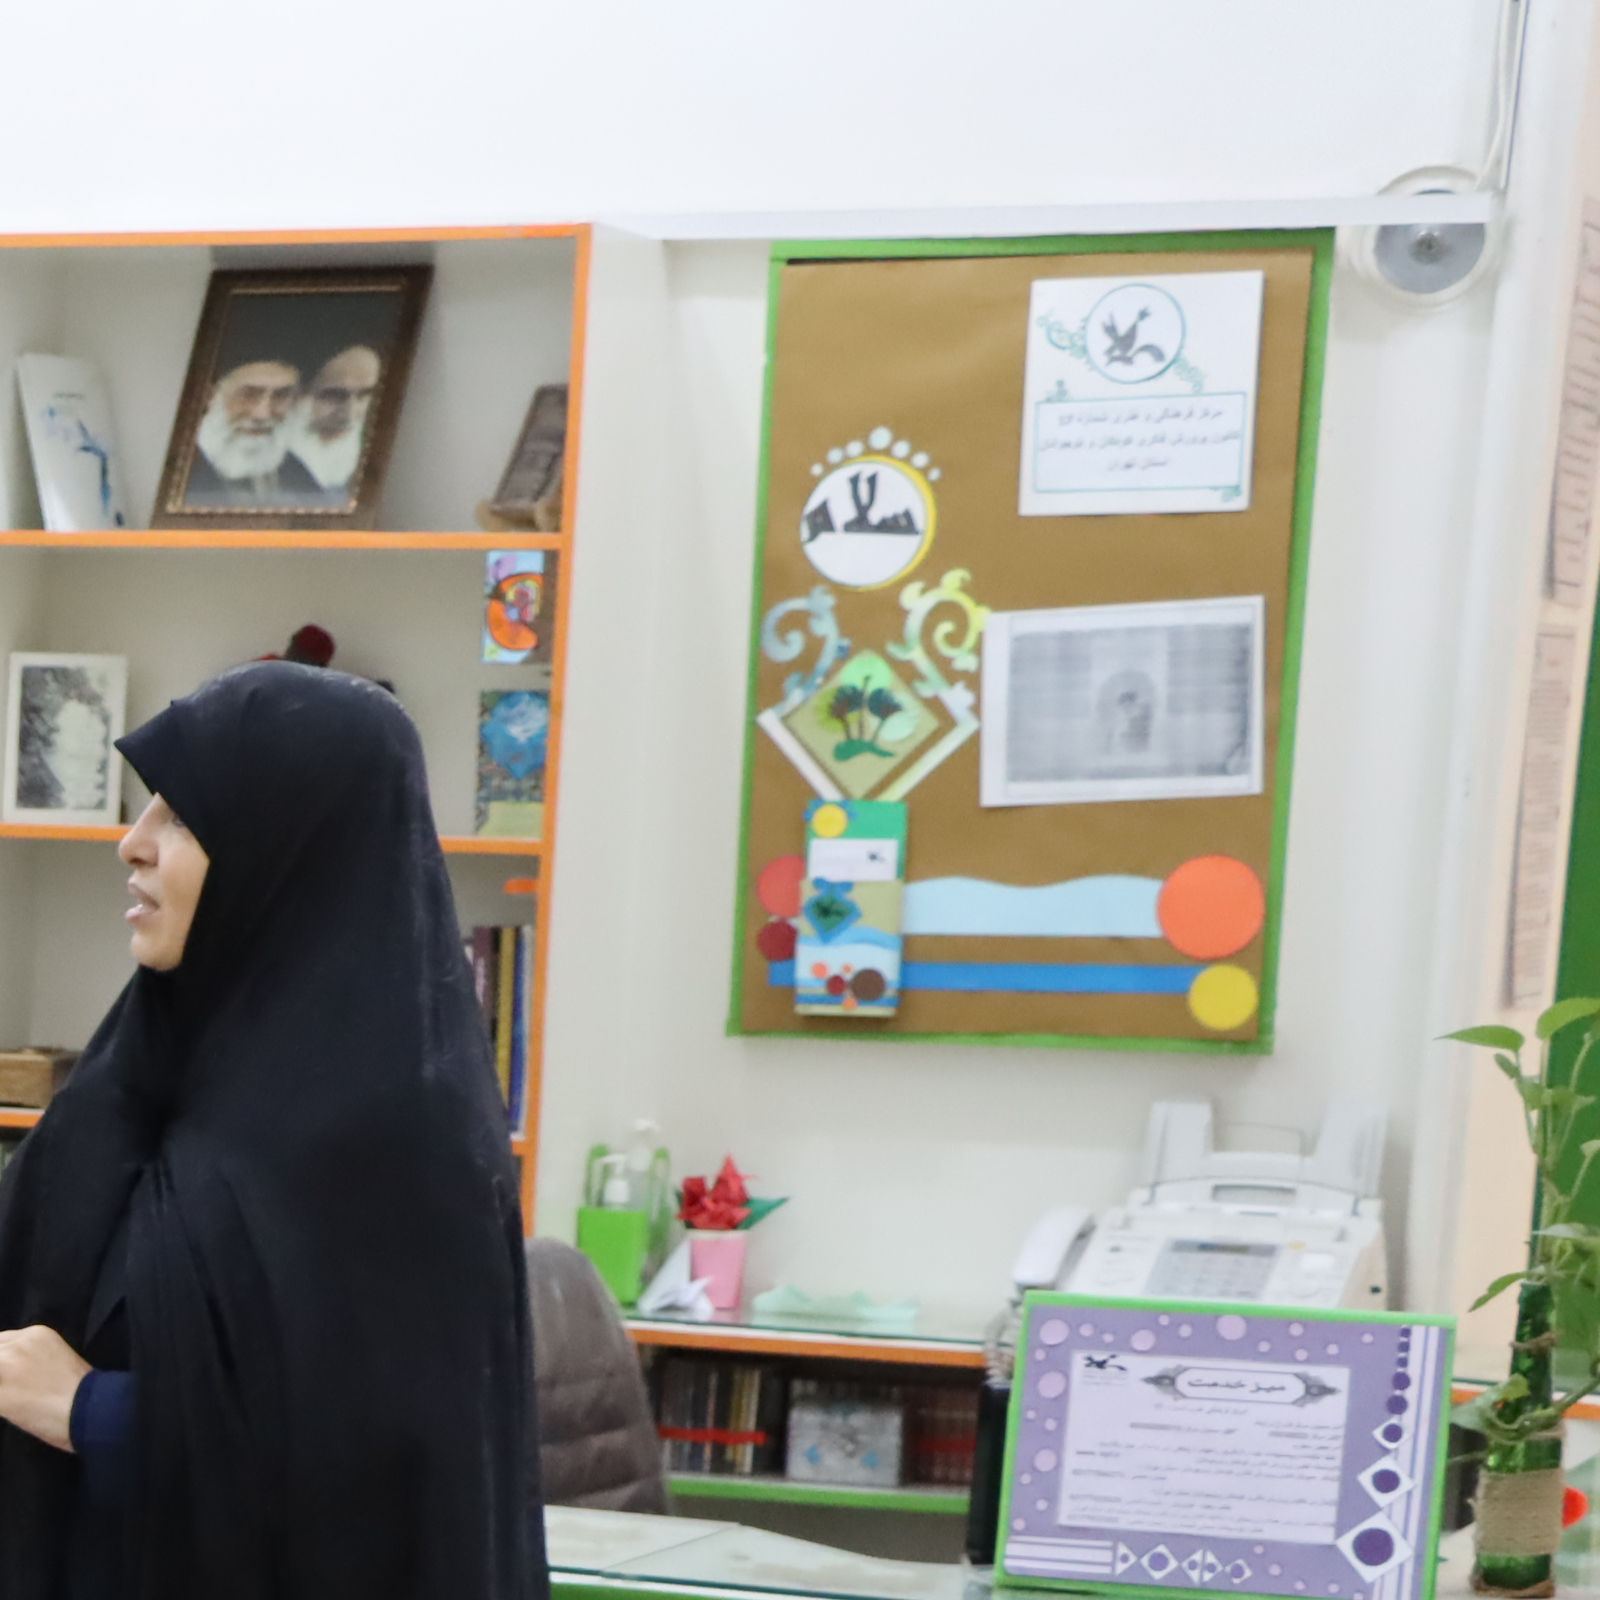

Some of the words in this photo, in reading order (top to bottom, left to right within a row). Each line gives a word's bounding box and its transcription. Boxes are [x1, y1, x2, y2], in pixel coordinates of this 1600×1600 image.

[803, 470, 920, 544] سلام
[1187, 1377, 1247, 1390] خدمت
[1248, 1380, 1287, 1394] میز
